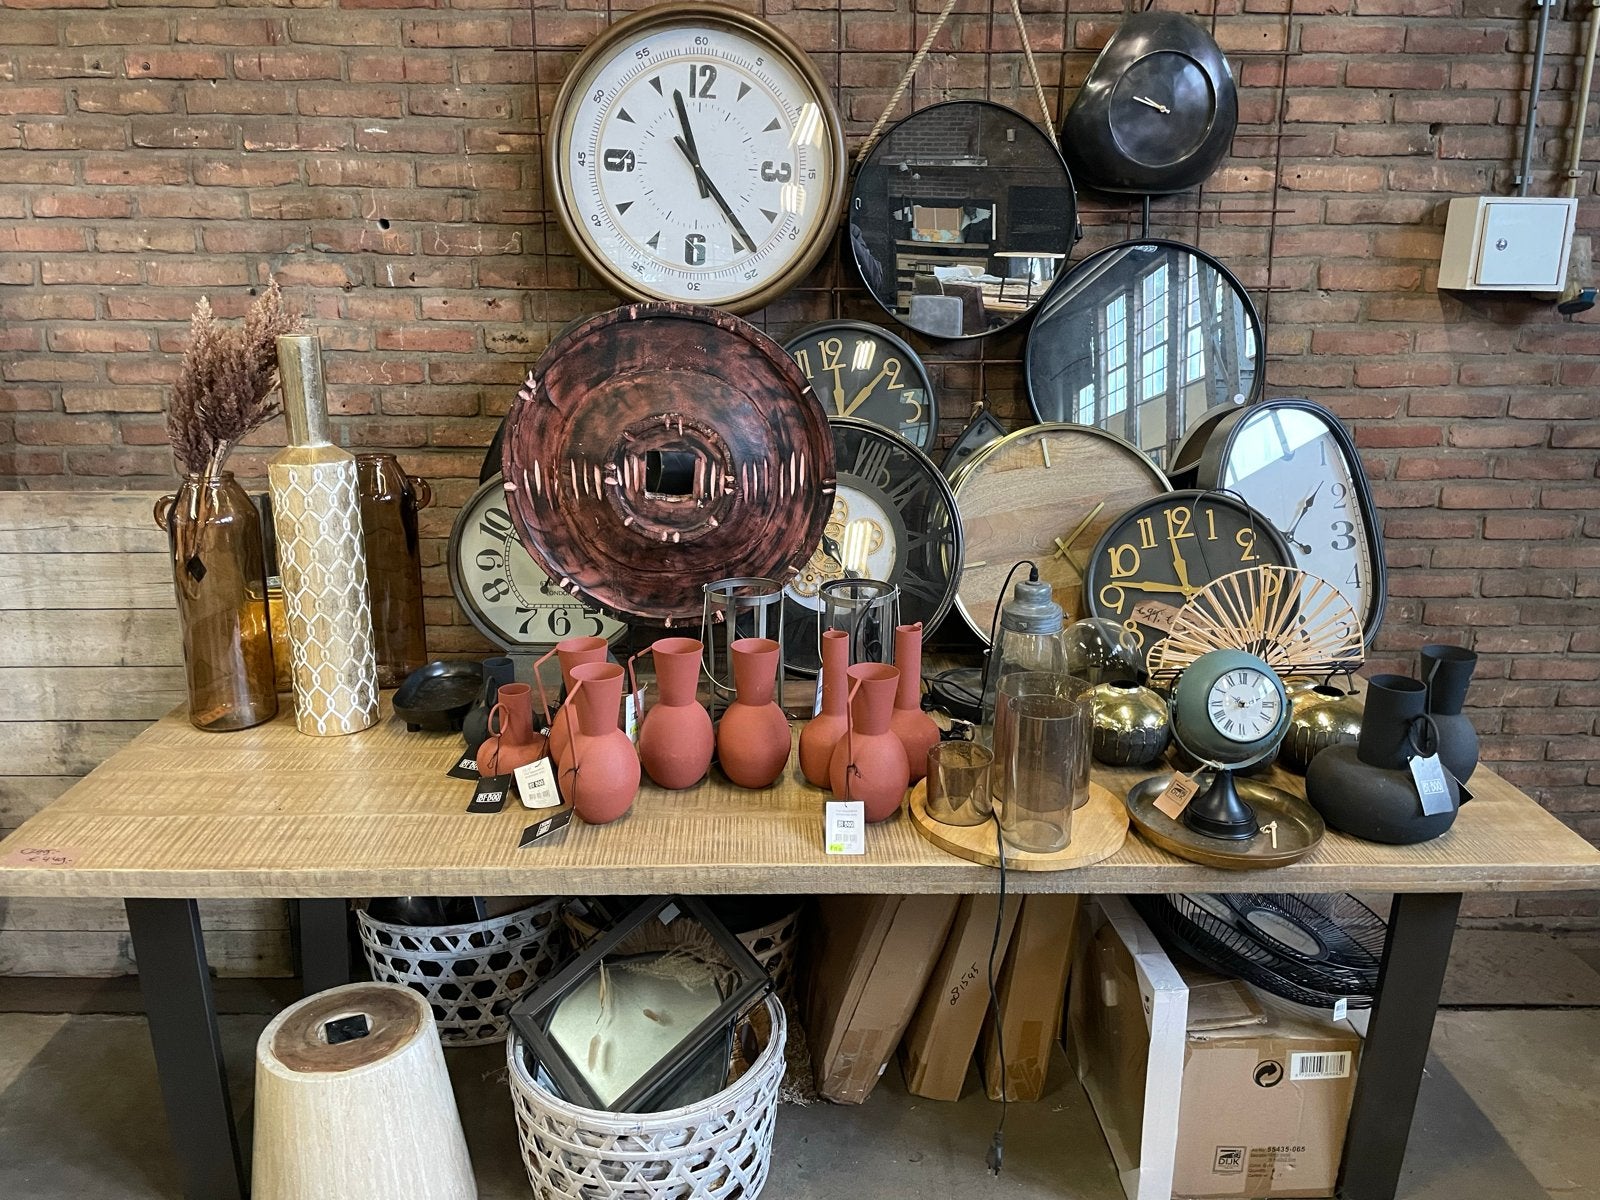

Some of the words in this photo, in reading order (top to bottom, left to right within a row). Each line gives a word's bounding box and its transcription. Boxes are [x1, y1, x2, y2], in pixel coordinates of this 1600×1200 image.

[635, 47, 650, 60] 55
[695, 36, 709, 46] 60
[756, 57, 765, 67] 5
[689, 64, 717, 99] 12
[593, 89, 605, 104] 50
[578, 151, 586, 167] 45
[604, 148, 636, 173] 9
[761, 161, 792, 183] 3
[808, 168, 816, 180] 15
[591, 214, 602, 227] 40
[788, 227, 800, 241] 20
[631, 261, 646, 274] 35
[744, 268, 758, 280] 25
[687, 282, 701, 291] 30
[794, 350, 814, 379] 11
[817, 337, 846, 371] 12
[883, 357, 904, 390] 2
[903, 391, 922, 424] 3
[1319, 441, 1327, 467] 1
[1331, 483, 1347, 509] 2
[479, 507, 514, 545] 10
[1137, 518, 1158, 549] 11
[1163, 506, 1195, 540] 12
[1206, 509, 1218, 540] 1
[1331, 520, 1357, 551] 3
[1235, 528, 1260, 561] 2
[475, 548, 504, 571] 9
[1108, 543, 1141, 578] 10
[1345, 562, 1362, 589] 4
[482, 578, 510, 603] 8
[1100, 583, 1125, 615] 9
[515, 607, 538, 635] 7
[547, 608, 571, 636] 6
[583, 608, 604, 637] 5
[1119, 619, 1144, 650] 8
